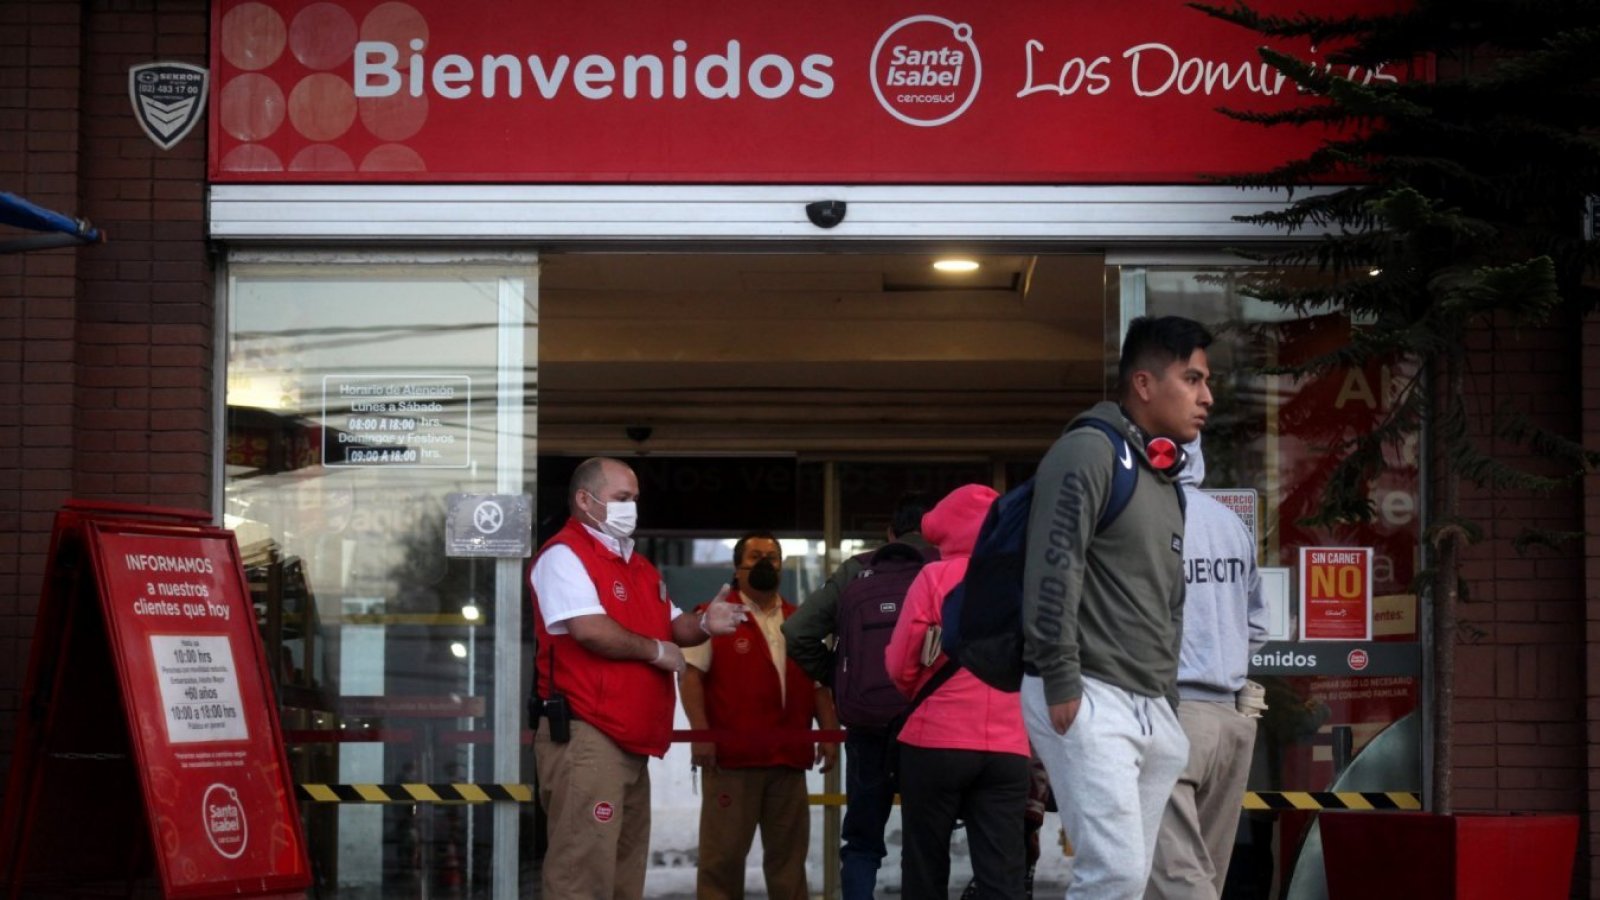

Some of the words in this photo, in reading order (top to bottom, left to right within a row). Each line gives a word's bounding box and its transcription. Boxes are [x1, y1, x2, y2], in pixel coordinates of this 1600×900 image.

[890, 45, 964, 66] Santa
[354, 38, 834, 99] Bienvenidos
[886, 65, 962, 86] Isabel
[1016, 39, 1112, 98] Los
[160, 73, 201, 81] SEKRON
[187, 86, 199, 94] 00
[897, 92, 955, 103] cencosud
[340, 384, 383, 395] Horario
[386, 384, 401, 395] de
[403, 383, 454, 395] Atención
[351, 401, 386, 412] Lunes
[388, 403, 396, 412] a
[399, 400, 443, 412] Sábado
[349, 418, 377, 430] 08:00
[379, 419, 387, 430] A
[389, 418, 416, 430] 18:00
[421, 416, 442, 427] hrs.
[338, 432, 396, 447] Domingos
[397, 435, 405, 447] y
[407, 433, 454, 444] Festivos
[351, 450, 379, 462] 09:00
[380, 450, 389, 462] A
[390, 450, 417, 462] 18:00
[420, 448, 442, 458] hrs.
[1044, 471, 1087, 571] SOUND
[125, 554, 214, 574] INFORMAMOS
[1311, 552, 1326, 564] SIN
[1327, 552, 1361, 564] CARNET
[147, 582, 156, 596] a
[158, 581, 210, 597] nuestros
[1311, 565, 1361, 598] NO
[133, 598, 181, 616] clientes
[183, 603, 206, 619] que
[207, 600, 230, 620] hoy
[173, 649, 198, 664] 10:00
[197, 649, 213, 664] hrs
[185, 686, 198, 700] +60
[198, 686, 219, 699] años
[171, 706, 193, 720] 10:00
[194, 708, 200, 720] a
[200, 704, 223, 719] 18:00
[223, 704, 237, 719] hrs
[209, 804, 238, 818] Santa
